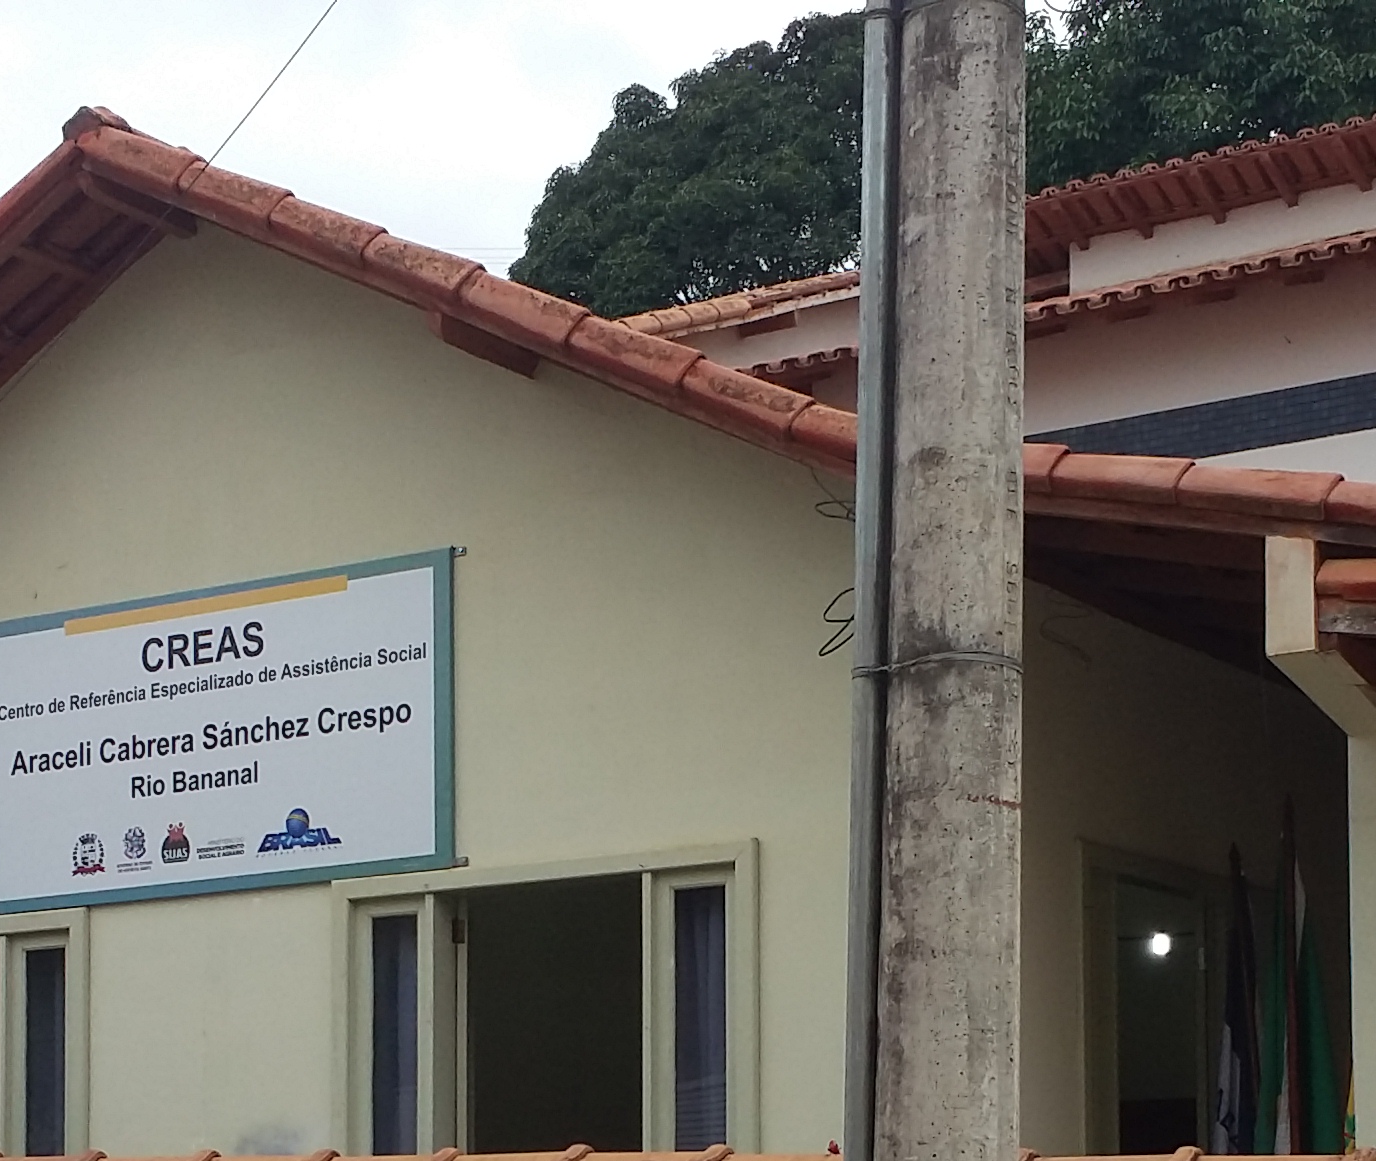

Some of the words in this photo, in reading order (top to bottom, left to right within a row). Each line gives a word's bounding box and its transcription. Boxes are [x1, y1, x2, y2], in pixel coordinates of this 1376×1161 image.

[141, 621, 264, 673] CREAS
[48, 697, 66, 714] de
[69, 685, 146, 711] Referência
[150, 669, 254, 701] Especializado
[258, 666, 277, 683] de
[280, 651, 372, 680] Assistência
[377, 642, 427, 665] Social
[10, 740, 91, 776] Araceli
[99, 733, 194, 764] Cabrera
[202, 717, 310, 750] Sánchez
[317, 703, 412, 734] Crespo
[131, 774, 166, 799] Rio
[172, 760, 258, 794] Bananal
[163, 848, 188, 860] SUAS
[257, 827, 342, 853] BRASIL
